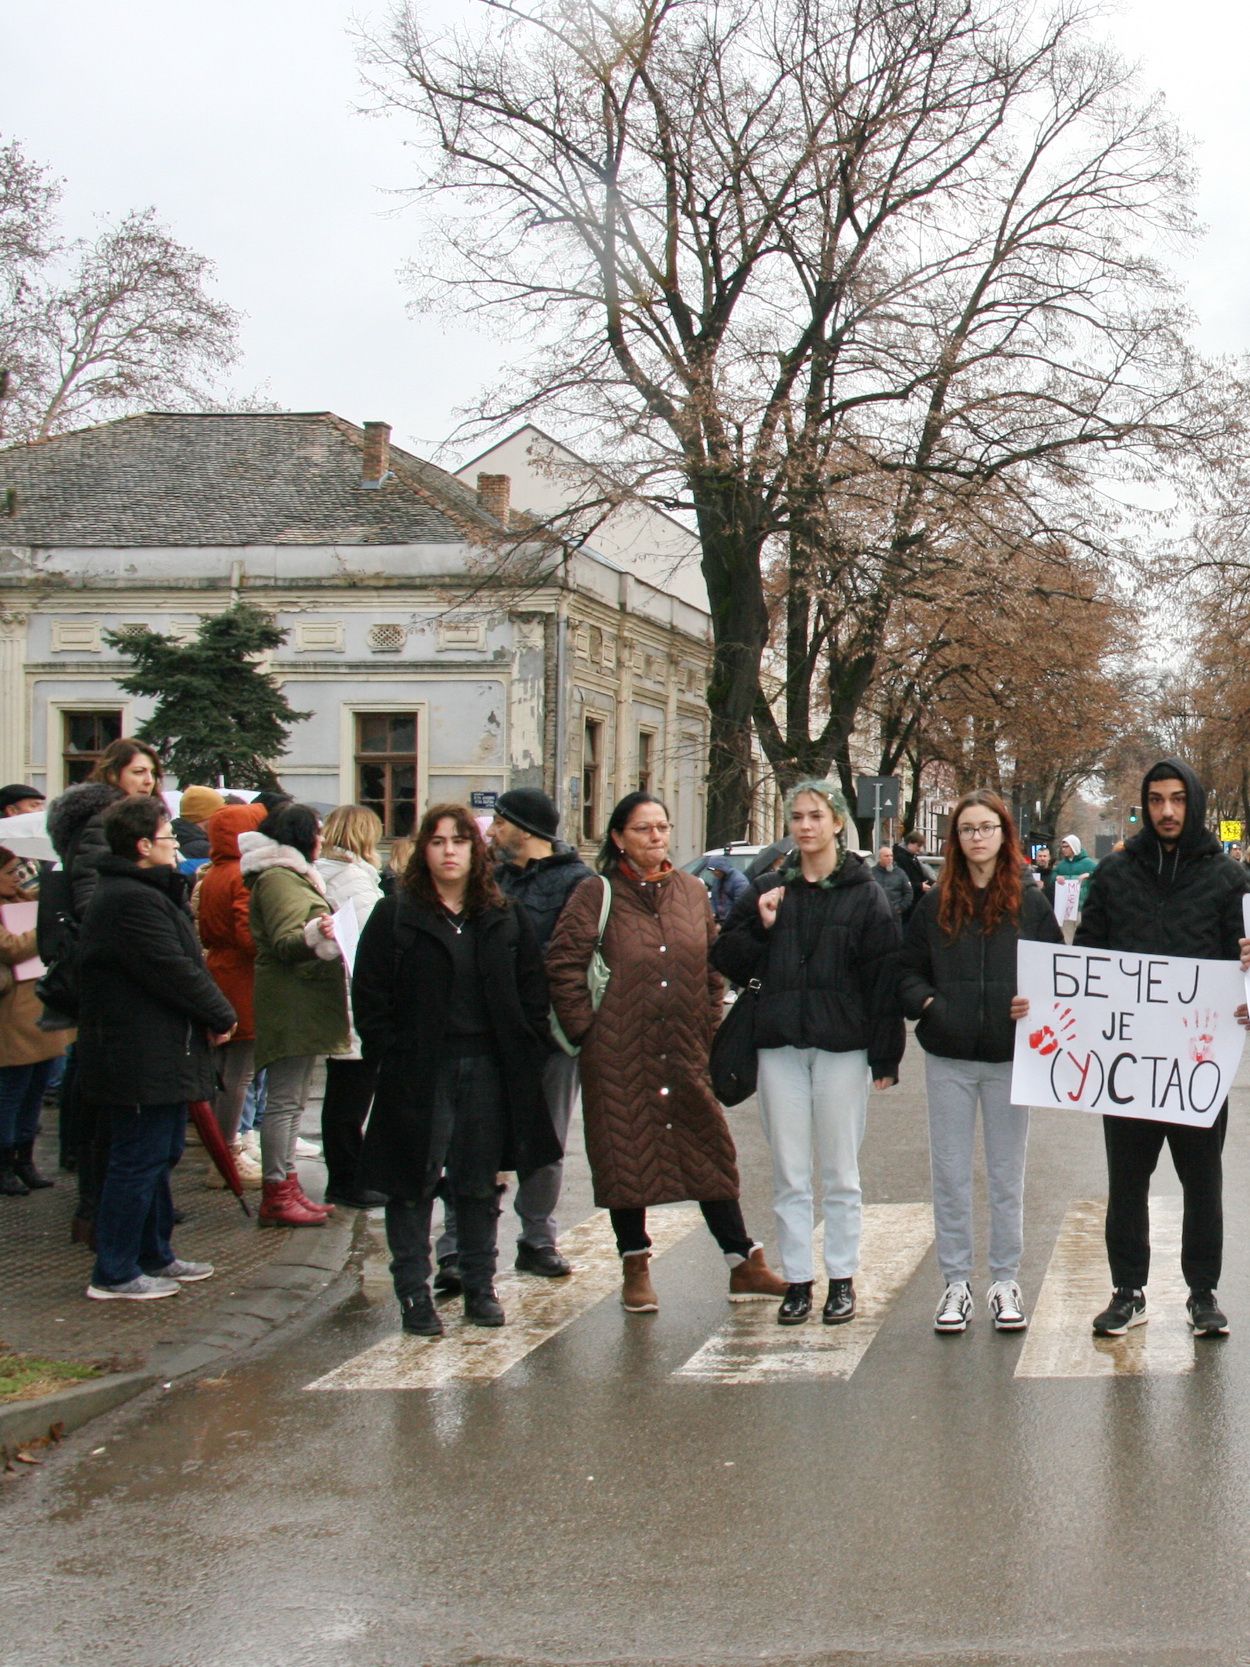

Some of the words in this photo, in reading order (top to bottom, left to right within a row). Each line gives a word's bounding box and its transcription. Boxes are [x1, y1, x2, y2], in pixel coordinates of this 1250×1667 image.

[1053, 953, 1200, 1004] БЕЧЕЈ
[1102, 1012, 1135, 1040] ЈЕ
[1050, 1048, 1221, 1113] (У)СТАО
